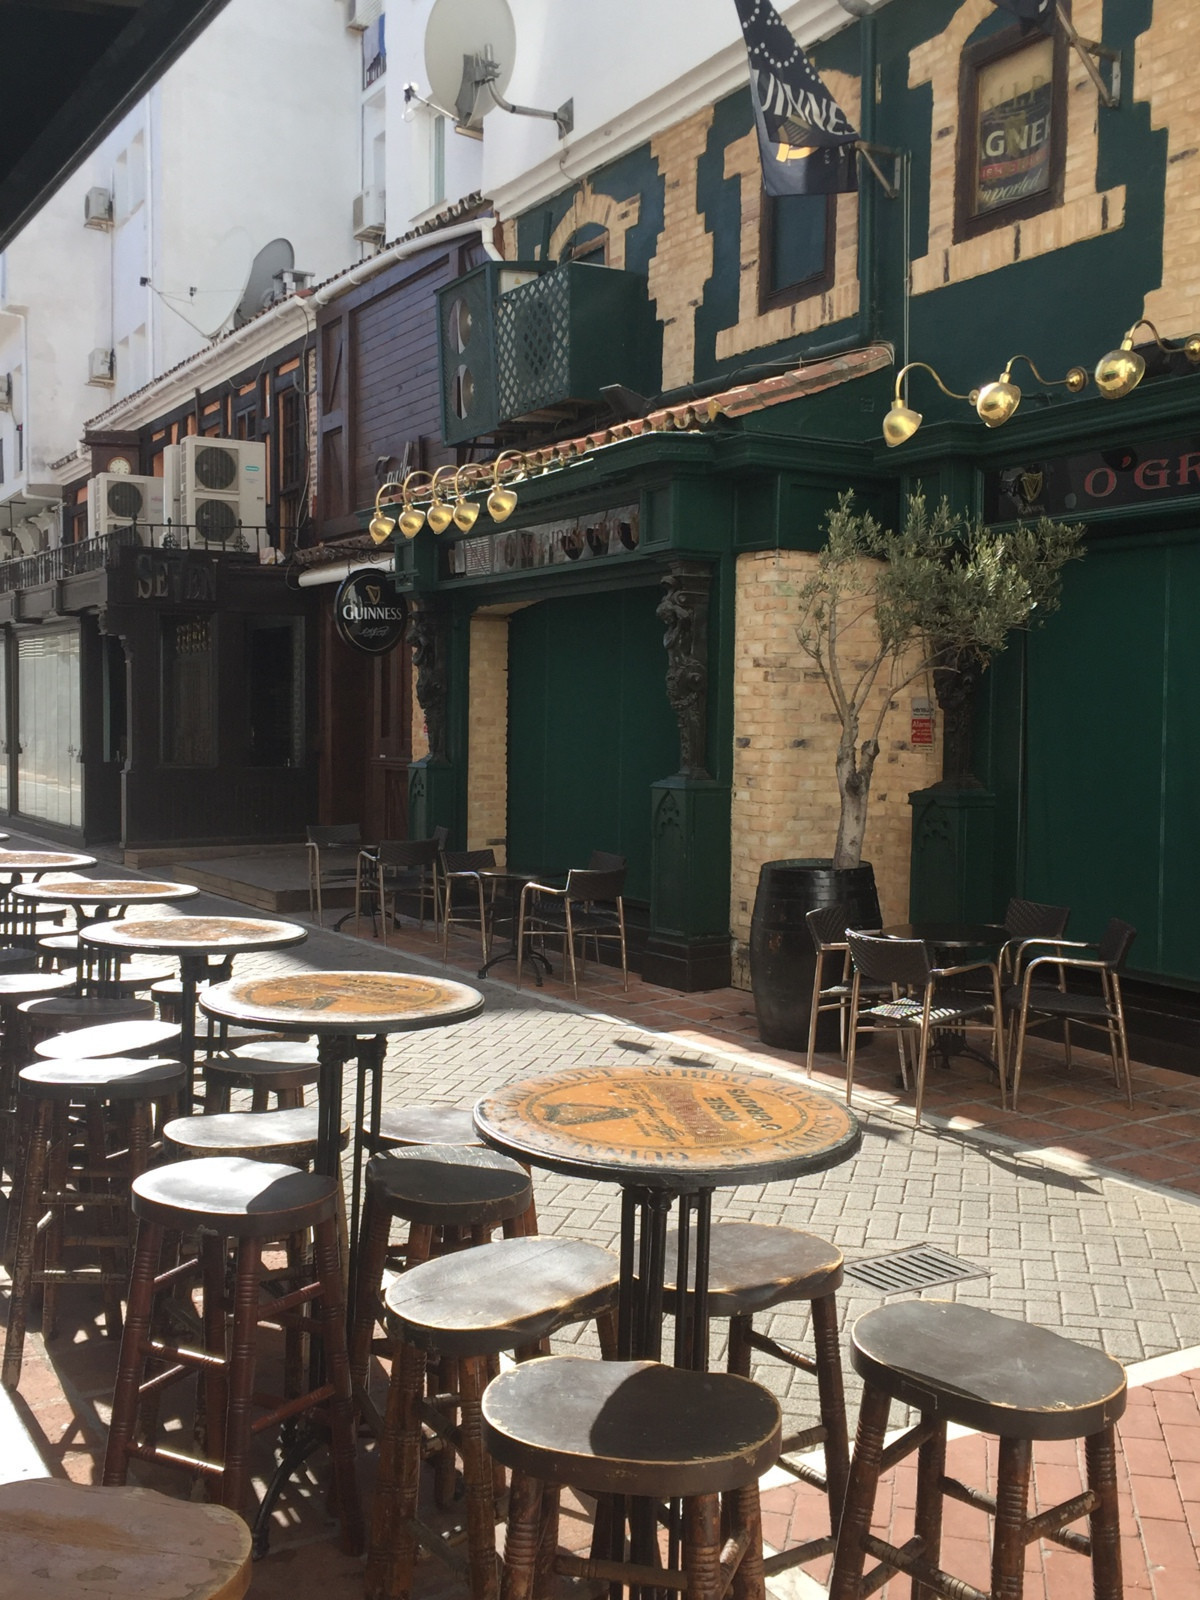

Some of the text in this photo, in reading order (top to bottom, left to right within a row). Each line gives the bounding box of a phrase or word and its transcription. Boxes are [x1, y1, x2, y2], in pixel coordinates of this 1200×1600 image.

[342, 604, 402, 620] GUINNESS
[644, 1067, 751, 1085] DUBLIN
[702, 1096, 742, 1122] ROSIE
[765, 1085, 833, 1112] GATE
